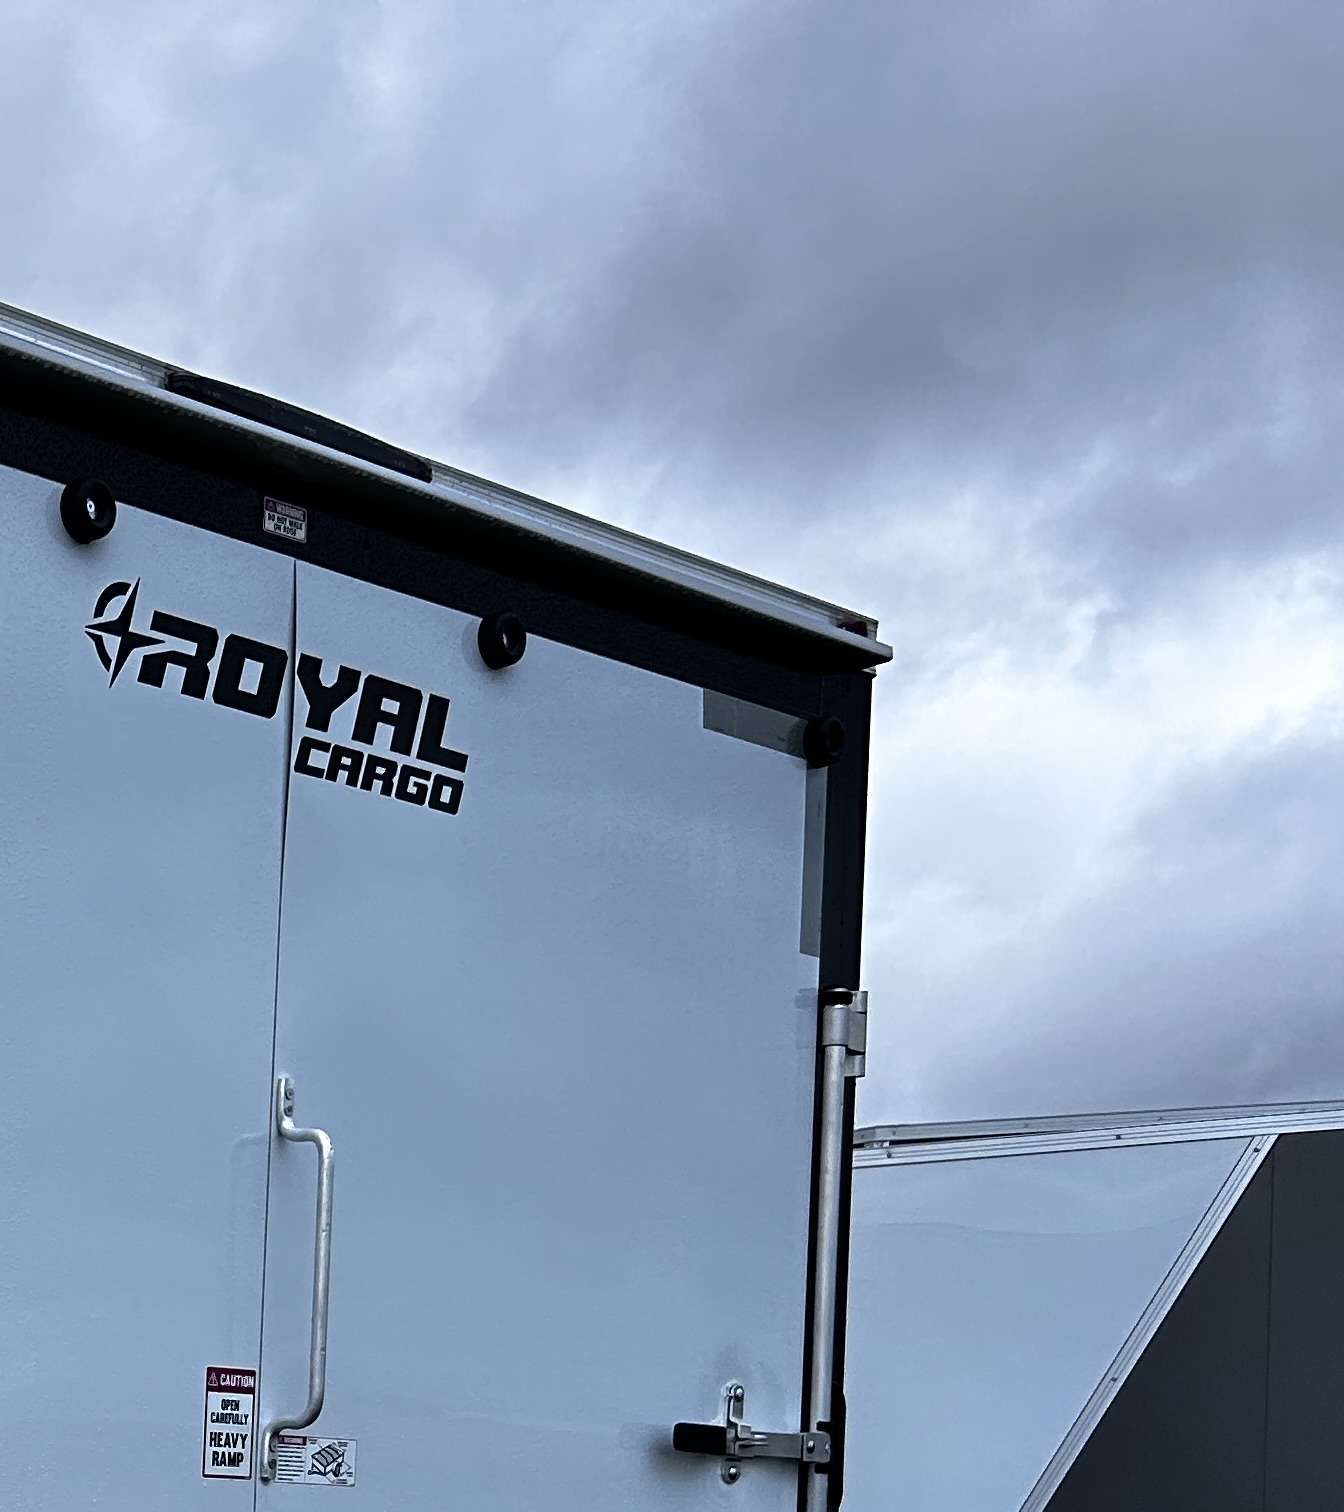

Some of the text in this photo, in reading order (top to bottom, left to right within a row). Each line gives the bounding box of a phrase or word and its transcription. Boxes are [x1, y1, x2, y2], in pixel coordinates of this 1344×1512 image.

[137, 609, 469, 774] ROYAL
[293, 736, 464, 816] CARGO
[220, 1373, 255, 1388] CAUTION
[209, 1431, 248, 1449] HEAVY
[211, 1450, 244, 1467] RAMP
